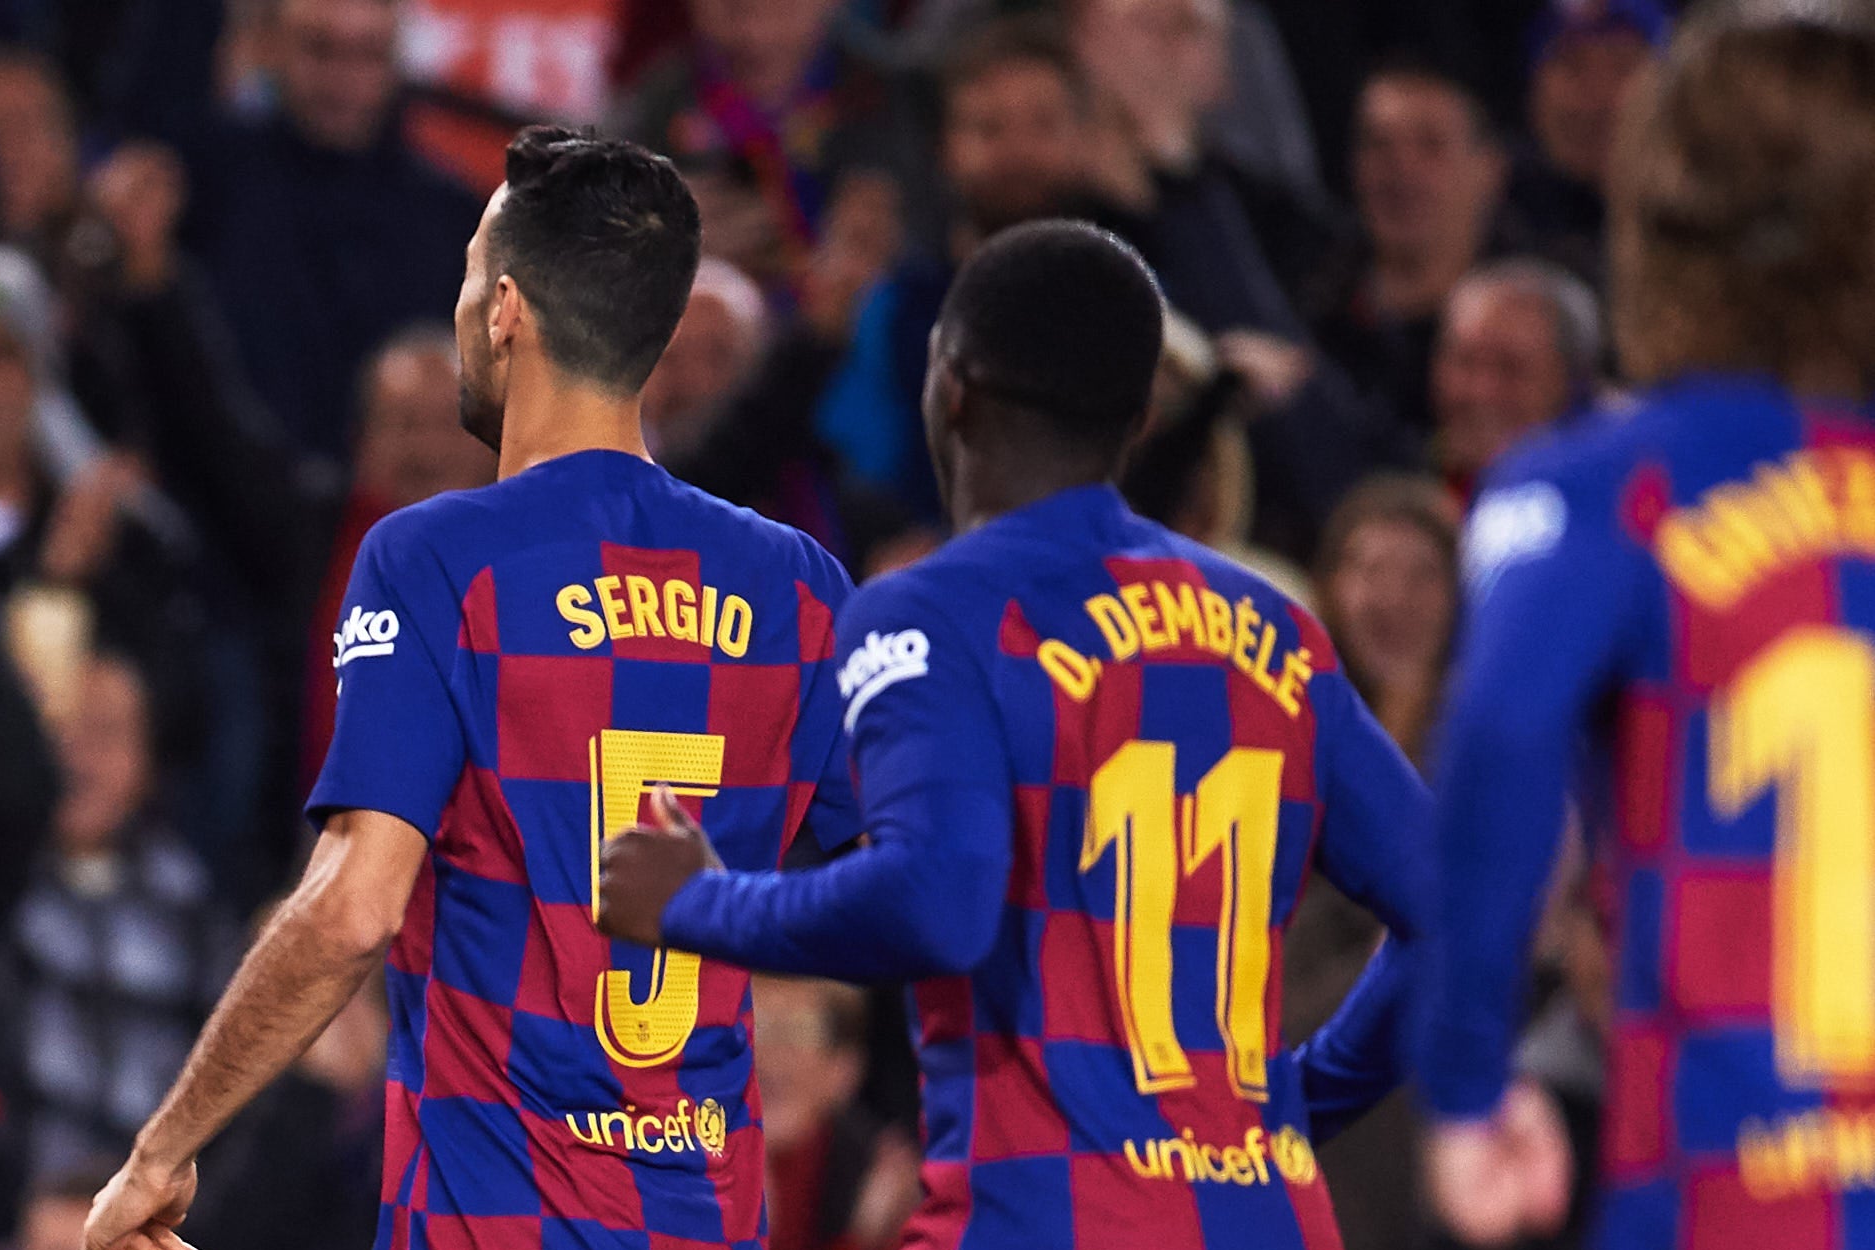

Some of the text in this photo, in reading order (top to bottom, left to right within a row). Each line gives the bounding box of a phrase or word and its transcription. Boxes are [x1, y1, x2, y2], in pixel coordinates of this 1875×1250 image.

[556, 575, 753, 658] SERGIO
[1036, 637, 1104, 703] O.
[1079, 739, 1284, 1104] 11
[565, 1098, 696, 1153] unicef
[1123, 1126, 1270, 1186] unicef
